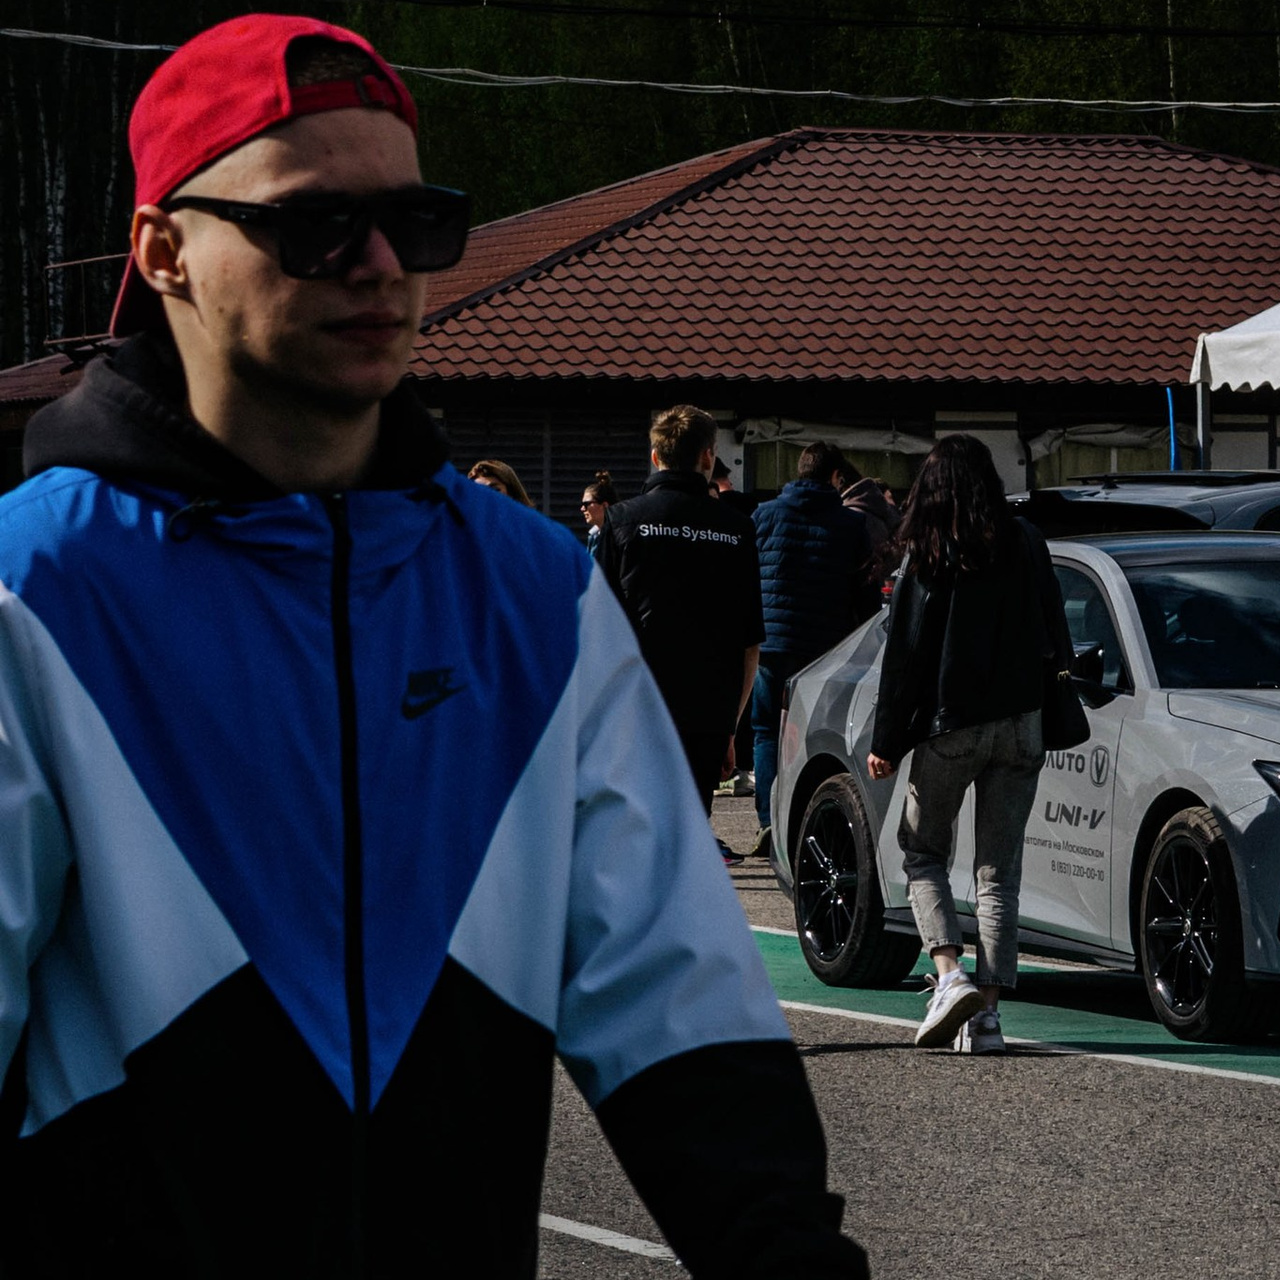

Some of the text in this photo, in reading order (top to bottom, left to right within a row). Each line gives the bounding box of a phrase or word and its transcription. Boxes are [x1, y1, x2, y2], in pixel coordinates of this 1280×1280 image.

[639, 523, 739, 546] Shine Systems
[1044, 801, 1106, 830] UNI-V
[1053, 840, 1062, 851] на
[1051, 860, 1057, 872] 8
